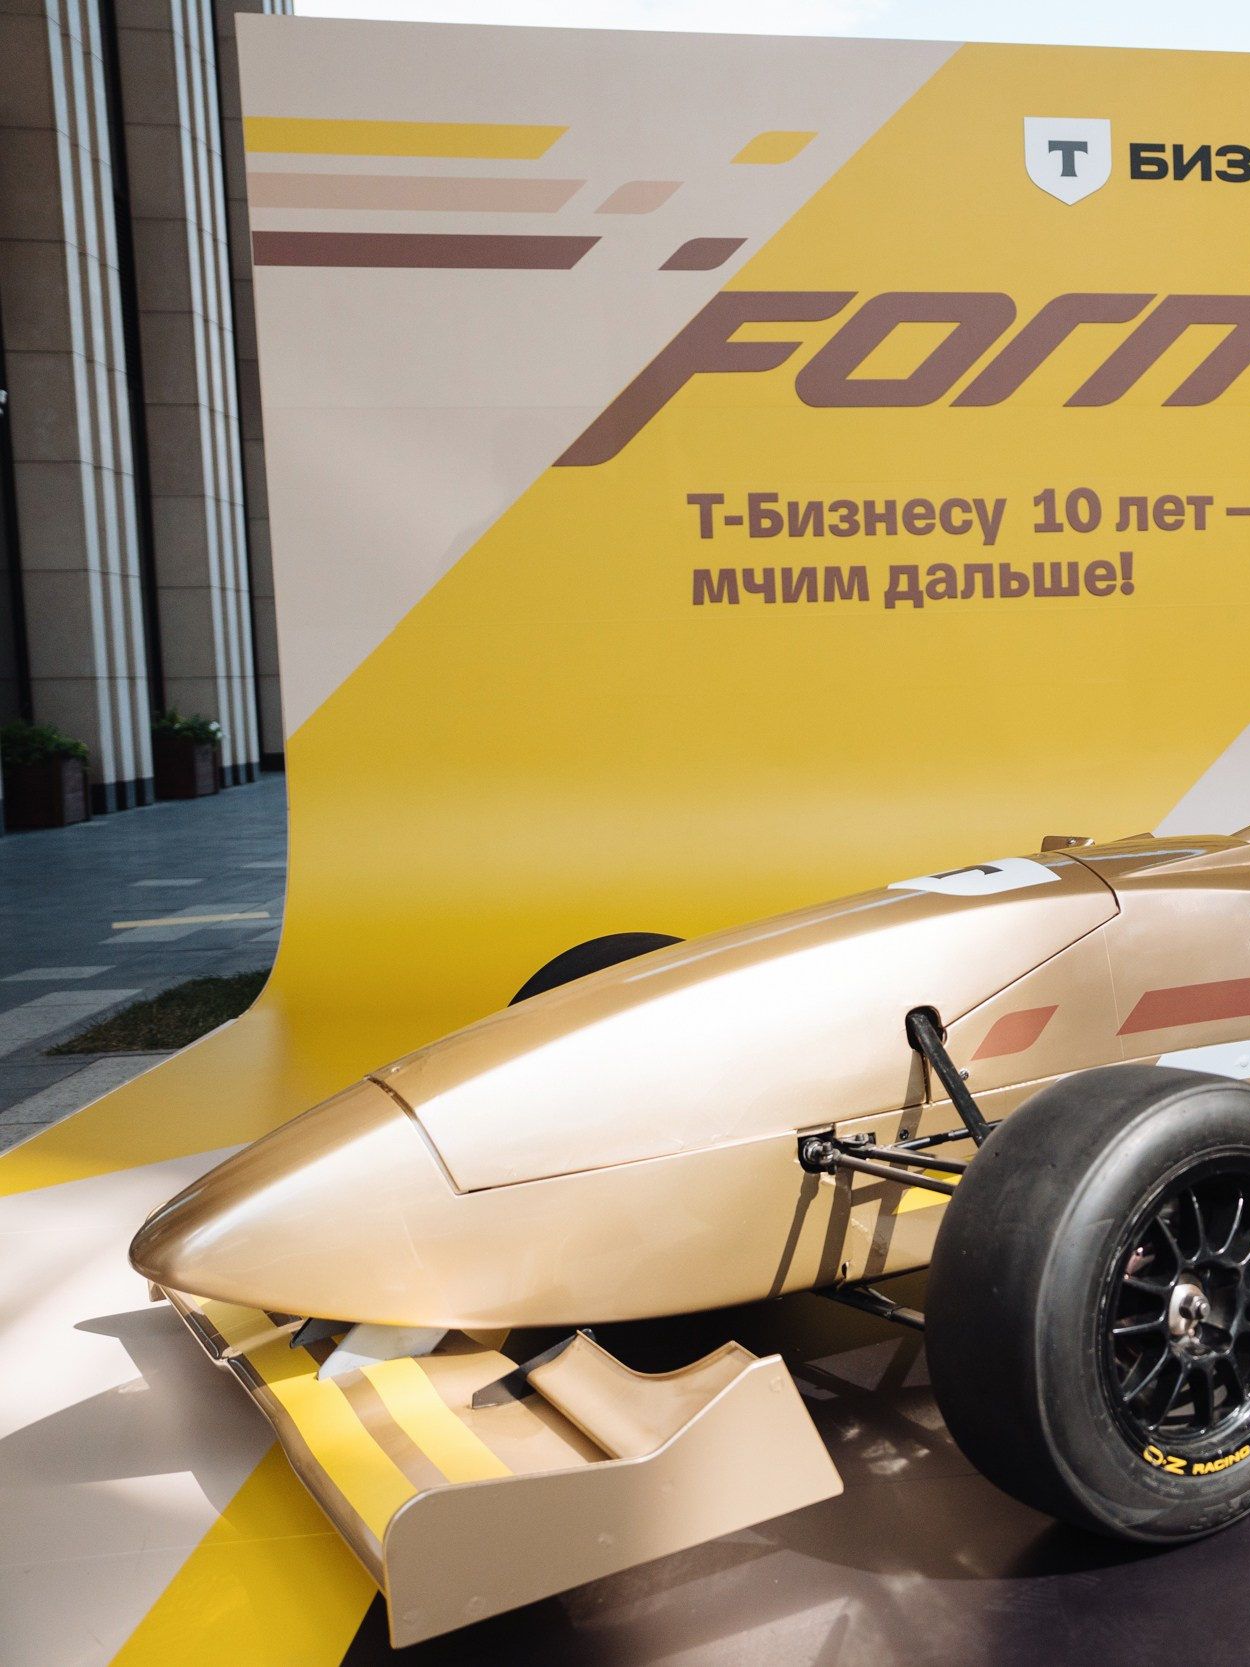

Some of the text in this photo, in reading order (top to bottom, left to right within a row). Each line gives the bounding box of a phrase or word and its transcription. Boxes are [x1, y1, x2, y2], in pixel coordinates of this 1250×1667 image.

[1048, 140, 1089, 178] Т
[686, 491, 1008, 546] Т-Бизнесу
[1033, 487, 1101, 534] 10
[1115, 494, 1215, 533] лет
[691, 551, 1136, 609] мчим дальше!
